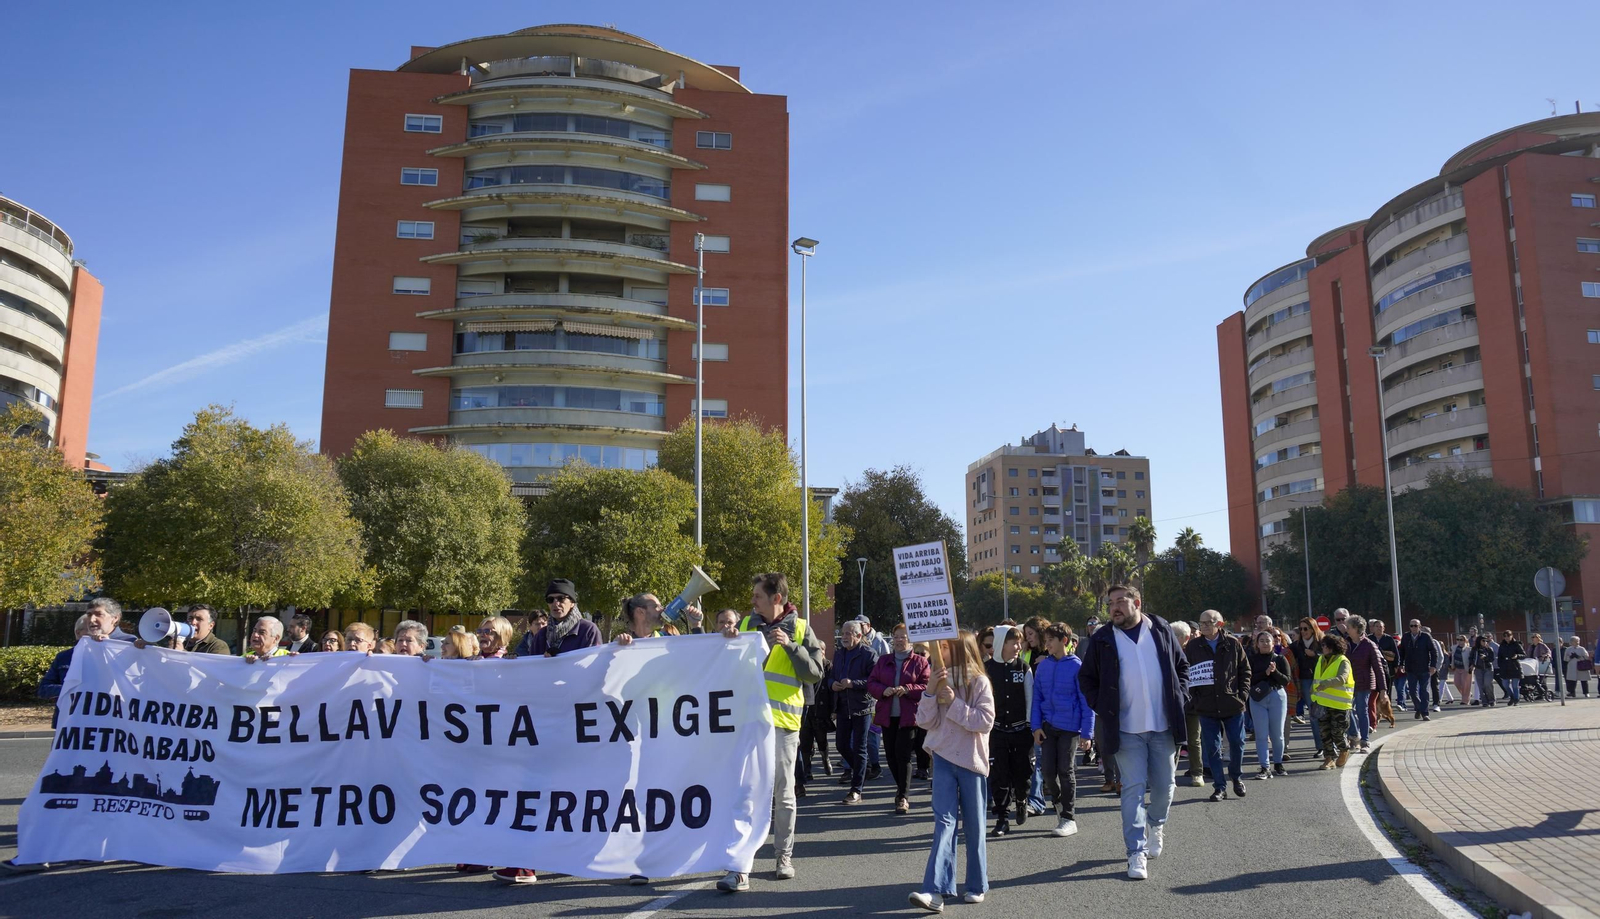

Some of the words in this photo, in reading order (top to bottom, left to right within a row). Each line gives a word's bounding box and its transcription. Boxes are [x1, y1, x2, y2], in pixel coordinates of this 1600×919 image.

[898, 552, 914, 560] VIDA
[914, 548, 940, 558] ARRIBA
[899, 560, 920, 570] METRO
[922, 558, 942, 566] ABAJO
[906, 602, 922, 610] VIDA
[924, 598, 948, 608] ARRIBA
[908, 610, 928, 620] METRO
[930, 608, 949, 617] ABAJO
[1013, 672, 1024, 683] 23
[69, 691, 123, 719] VIDA
[128, 698, 218, 730] ARRIBA
[228, 698, 539, 747] BELLAVISTA
[574, 690, 735, 744] EXIGE
[55, 727, 139, 756] METRO
[143, 736, 216, 763] ABAJO
[92, 798, 175, 820] RESPETO
[241, 784, 396, 828] METRO
[419, 784, 712, 833] SOTERRADO
